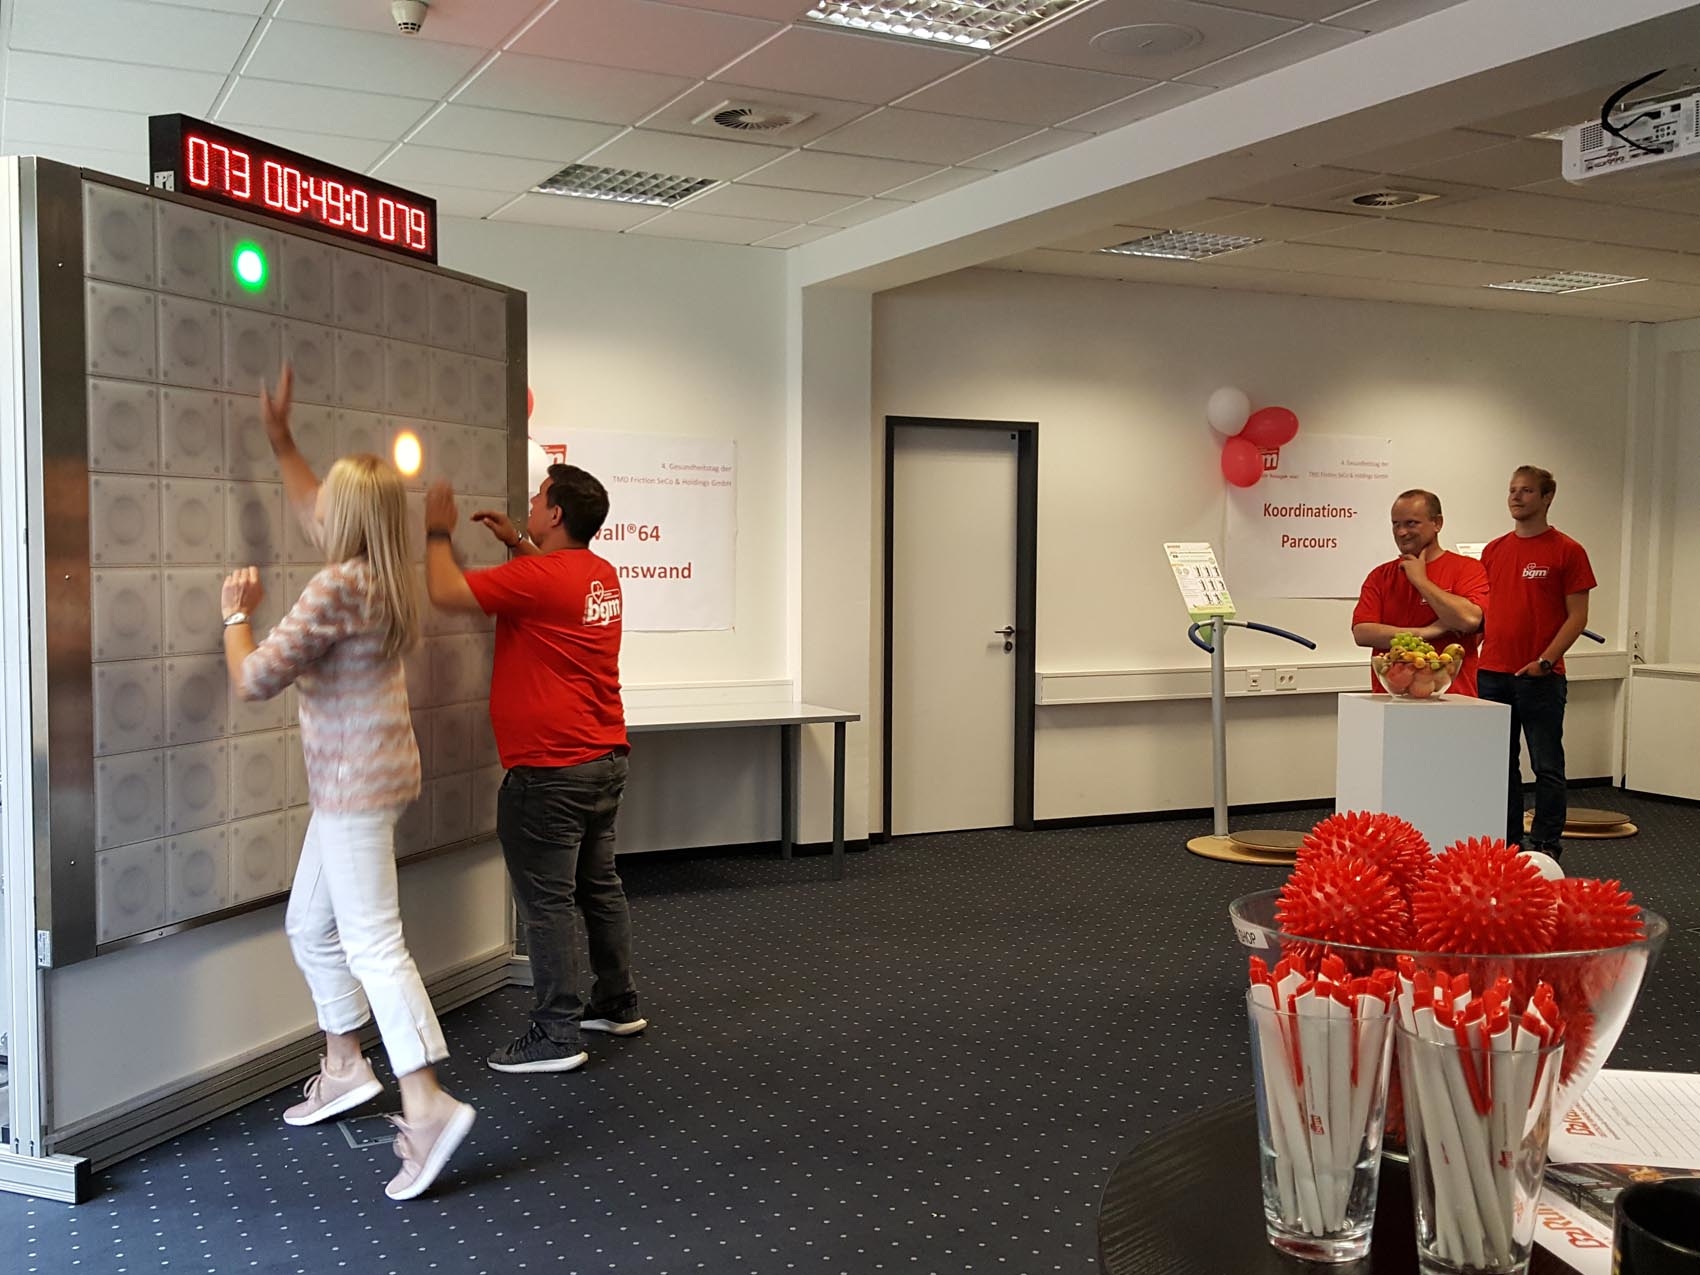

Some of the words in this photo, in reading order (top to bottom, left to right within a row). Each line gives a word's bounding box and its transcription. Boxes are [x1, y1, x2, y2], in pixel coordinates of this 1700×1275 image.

[188, 136, 250, 198] 073
[378, 197, 425, 249] 079
[1263, 503, 1358, 518] Koordinations-
[1281, 534, 1337, 548] Parcours
[619, 562, 691, 579] nswand
[1522, 568, 1547, 579] bgm
[586, 597, 620, 626] bgm
